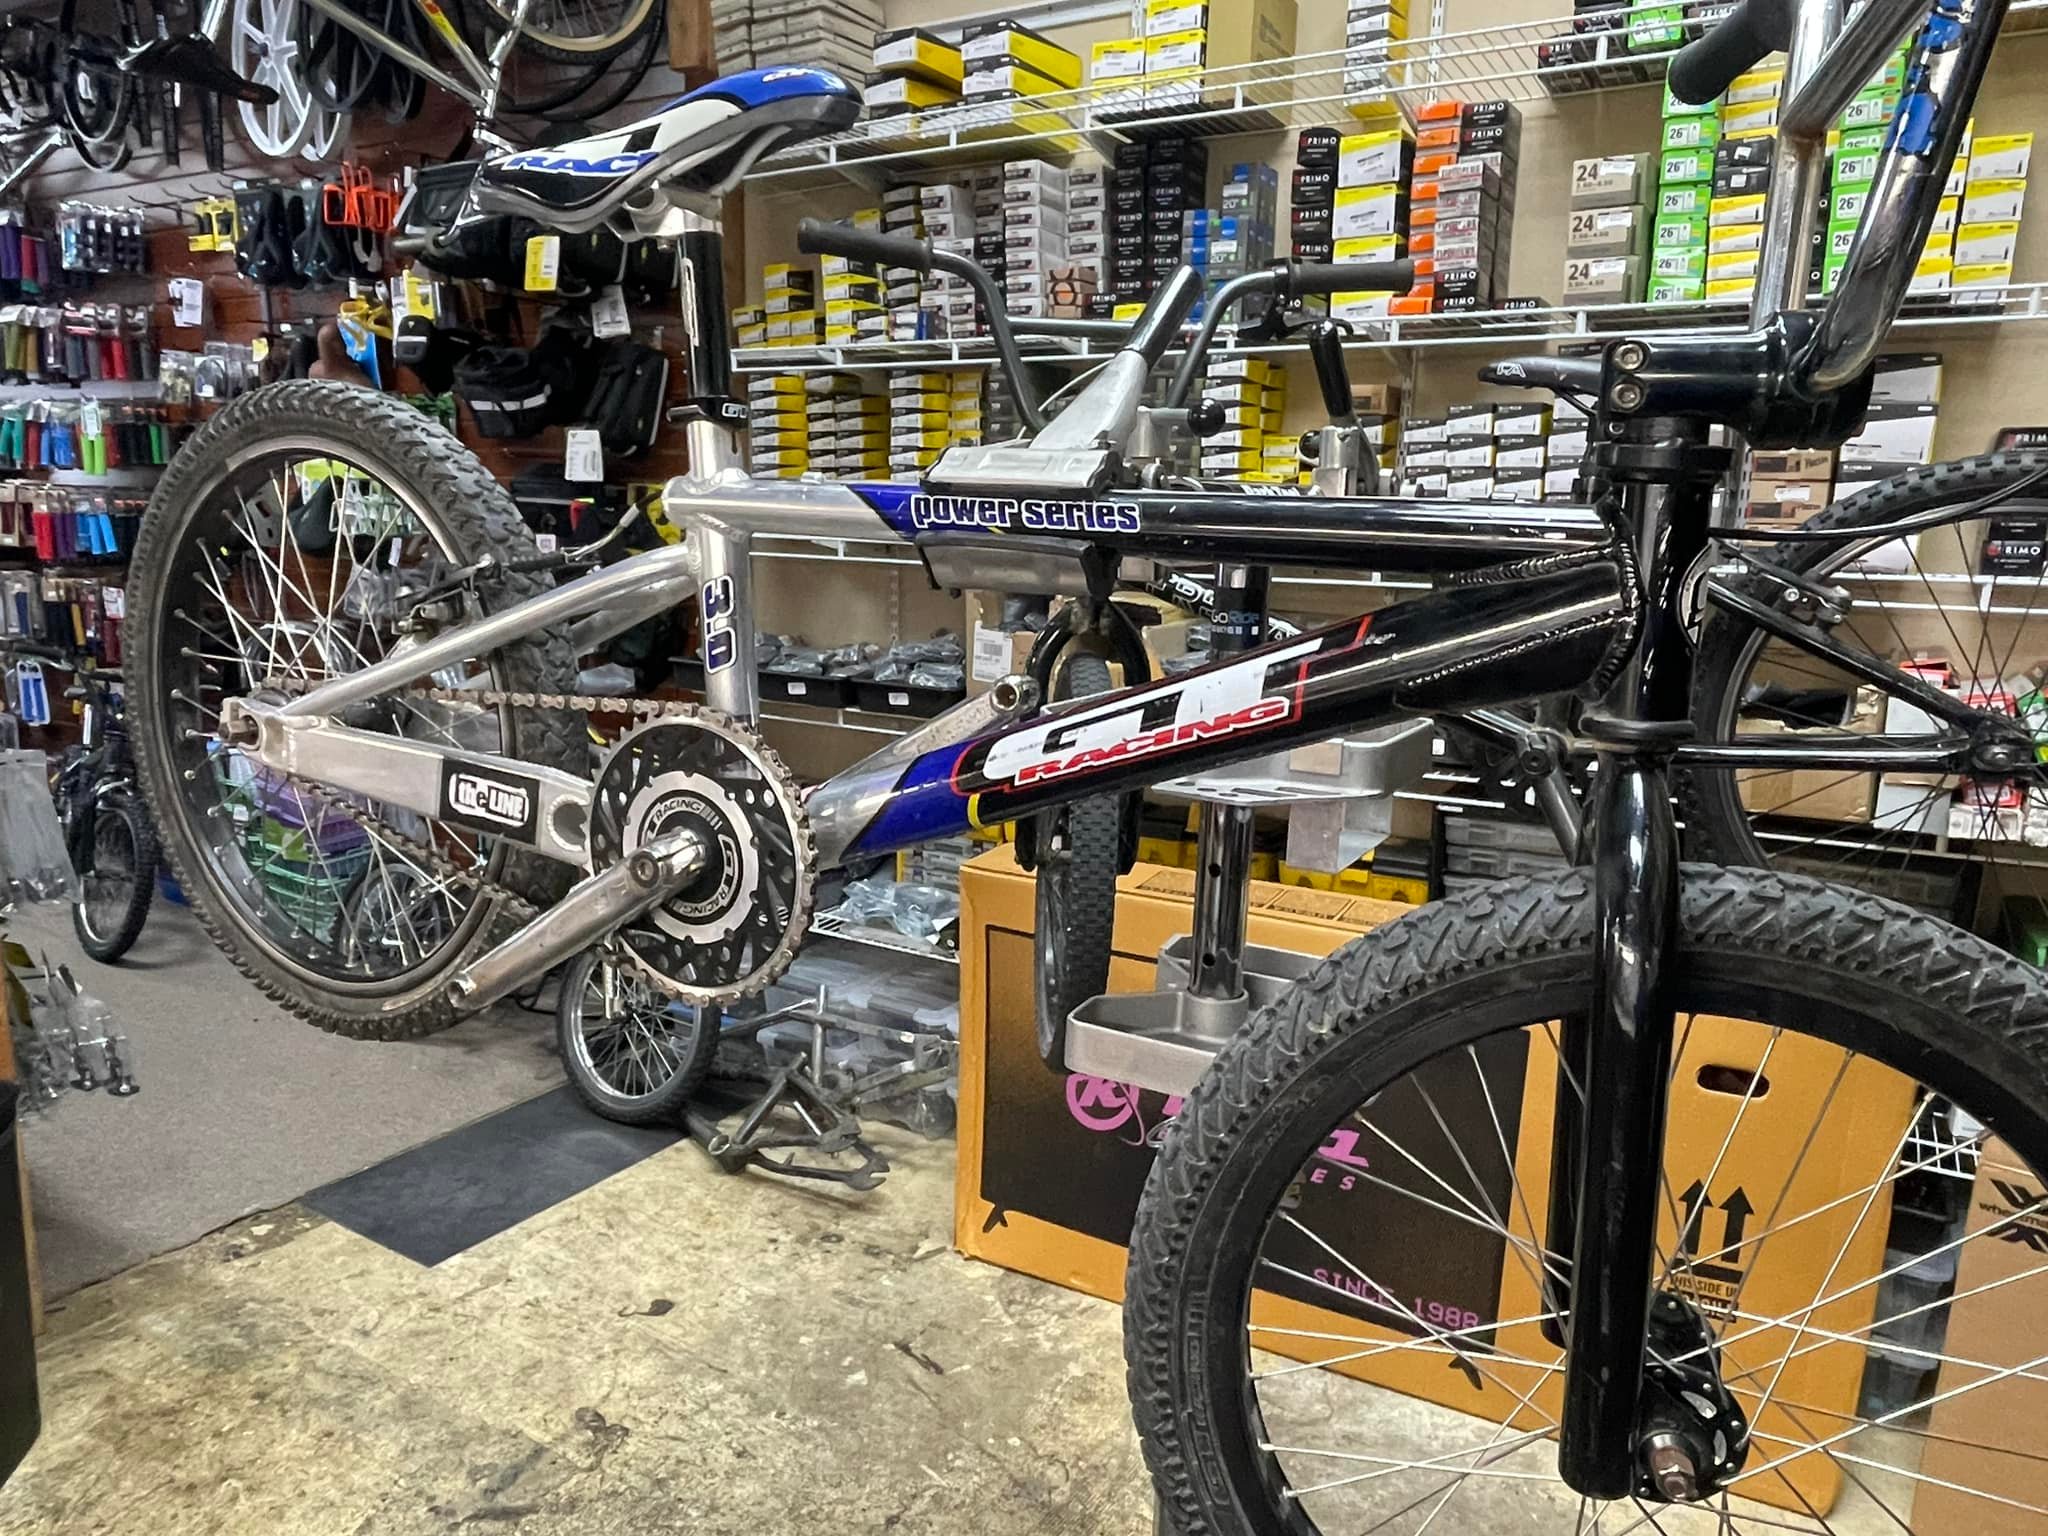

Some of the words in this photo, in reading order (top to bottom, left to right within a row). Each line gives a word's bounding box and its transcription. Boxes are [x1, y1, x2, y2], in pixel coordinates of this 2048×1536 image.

[1474, 103, 1505, 113] PRIMO
[1471, 128, 1503, 139] PRIMO
[1307, 136, 1337, 145] PRIMO
[1577, 163, 1598, 182] 24
[1301, 174, 1330, 185] PRIMO
[1300, 209, 1329, 219] PRIMO
[1572, 215, 1594, 232] 24
[1300, 245, 1329, 254] PRIMO
[1445, 271, 1477, 281] PRIMO
[1568, 263, 1590, 281] 24
[1092, 294, 1117, 303] PRIMO
[1443, 297, 1476, 307] PRIMO
[1504, 301, 1537, 310] PRIMO
[911, 494, 1018, 530] power
[1021, 500, 1141, 533] series
[983, 637, 1324, 781] GT
[1014, 695, 1289, 787] RACING
[458, 781, 487, 809] the
[488, 788, 523, 820] LINE
[654, 799, 703, 822] RACING
[1697, 1280, 1722, 1296] SIDE
[1313, 1267, 1395, 1308] SINCE
[1413, 1296, 1479, 1330] 1988
